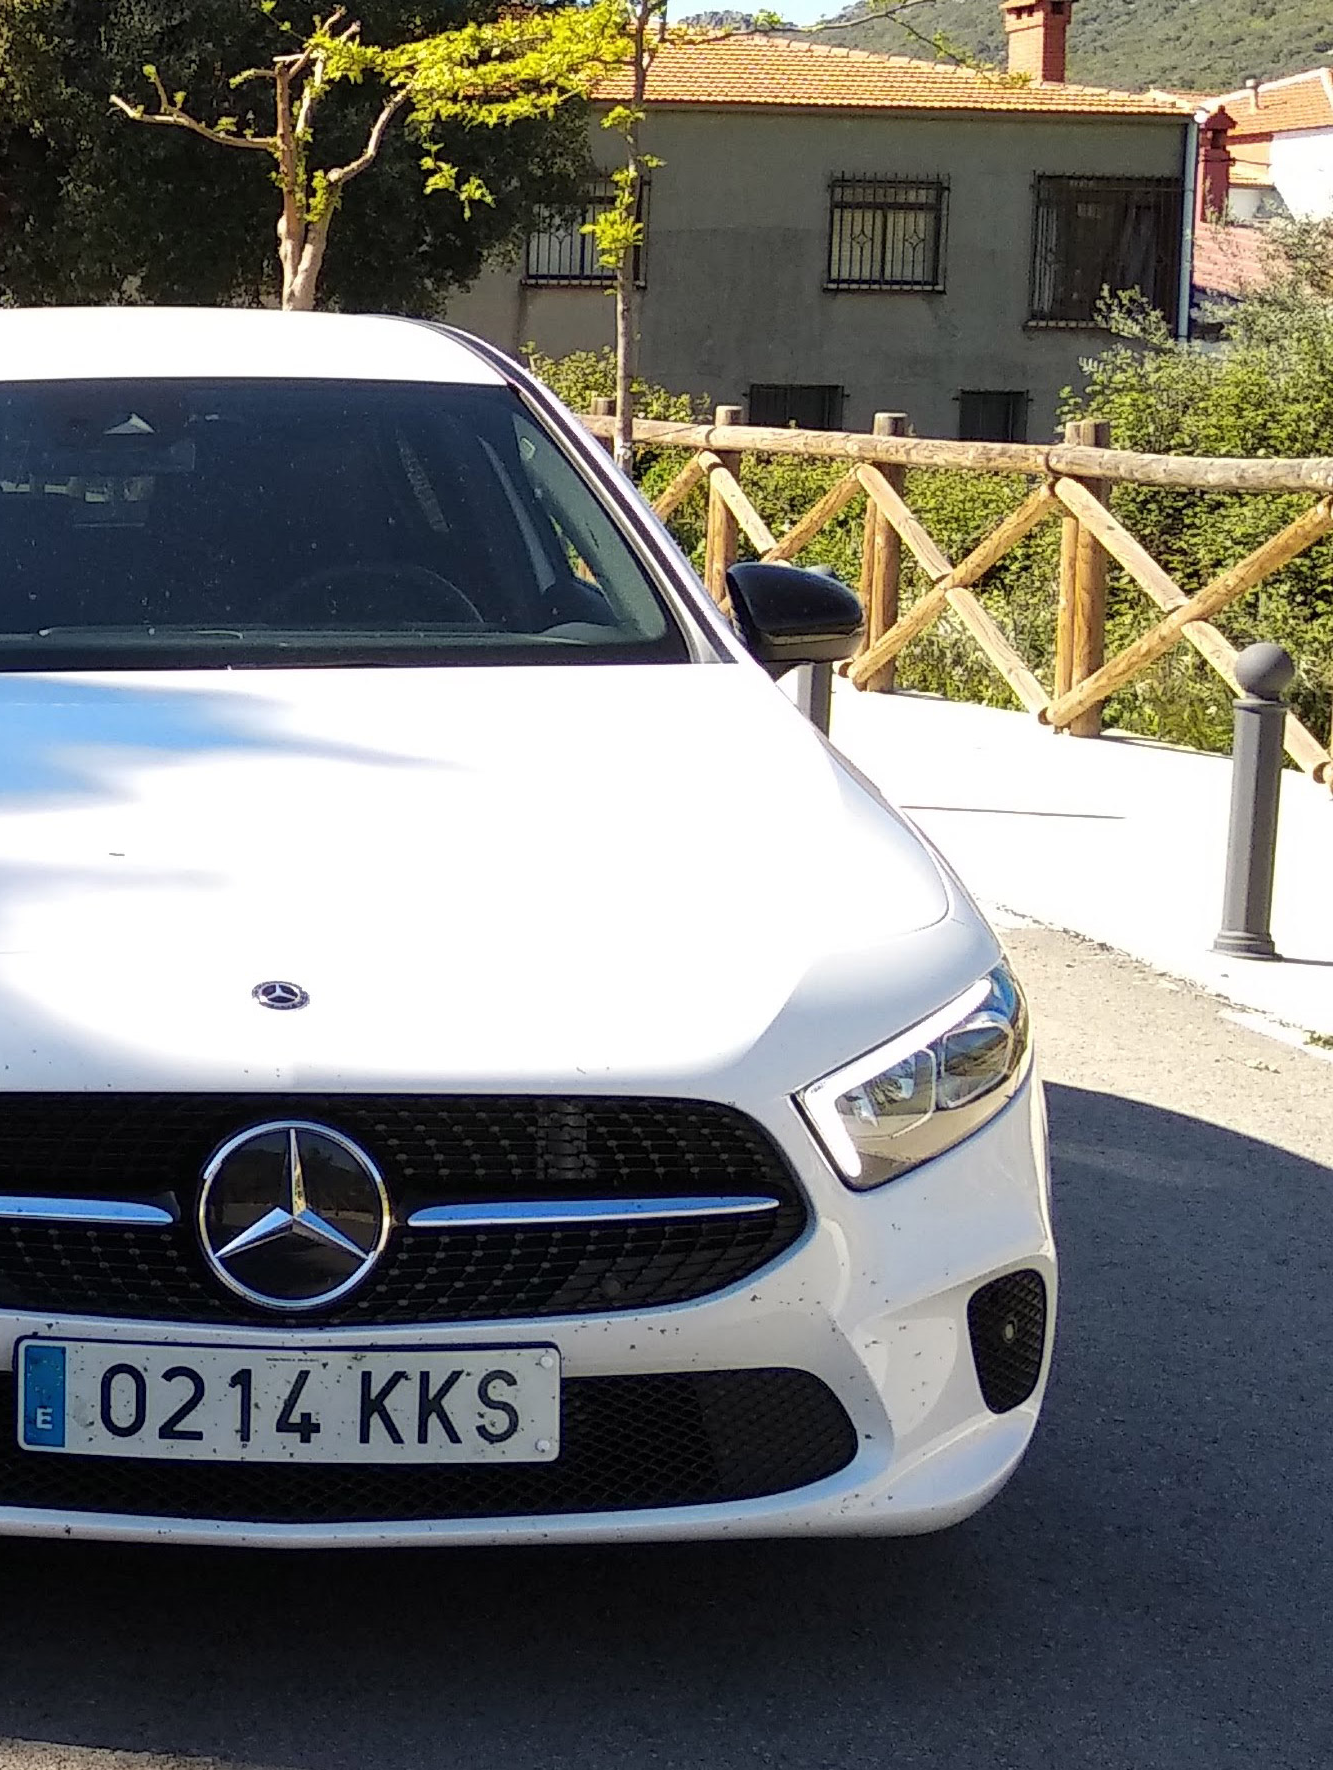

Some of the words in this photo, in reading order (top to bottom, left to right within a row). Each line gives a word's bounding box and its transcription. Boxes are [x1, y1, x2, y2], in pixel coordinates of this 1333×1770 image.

[36, 1407, 53, 1430] E
[99, 1362, 321, 1444] 0214
[359, 1368, 520, 1446] KKS
